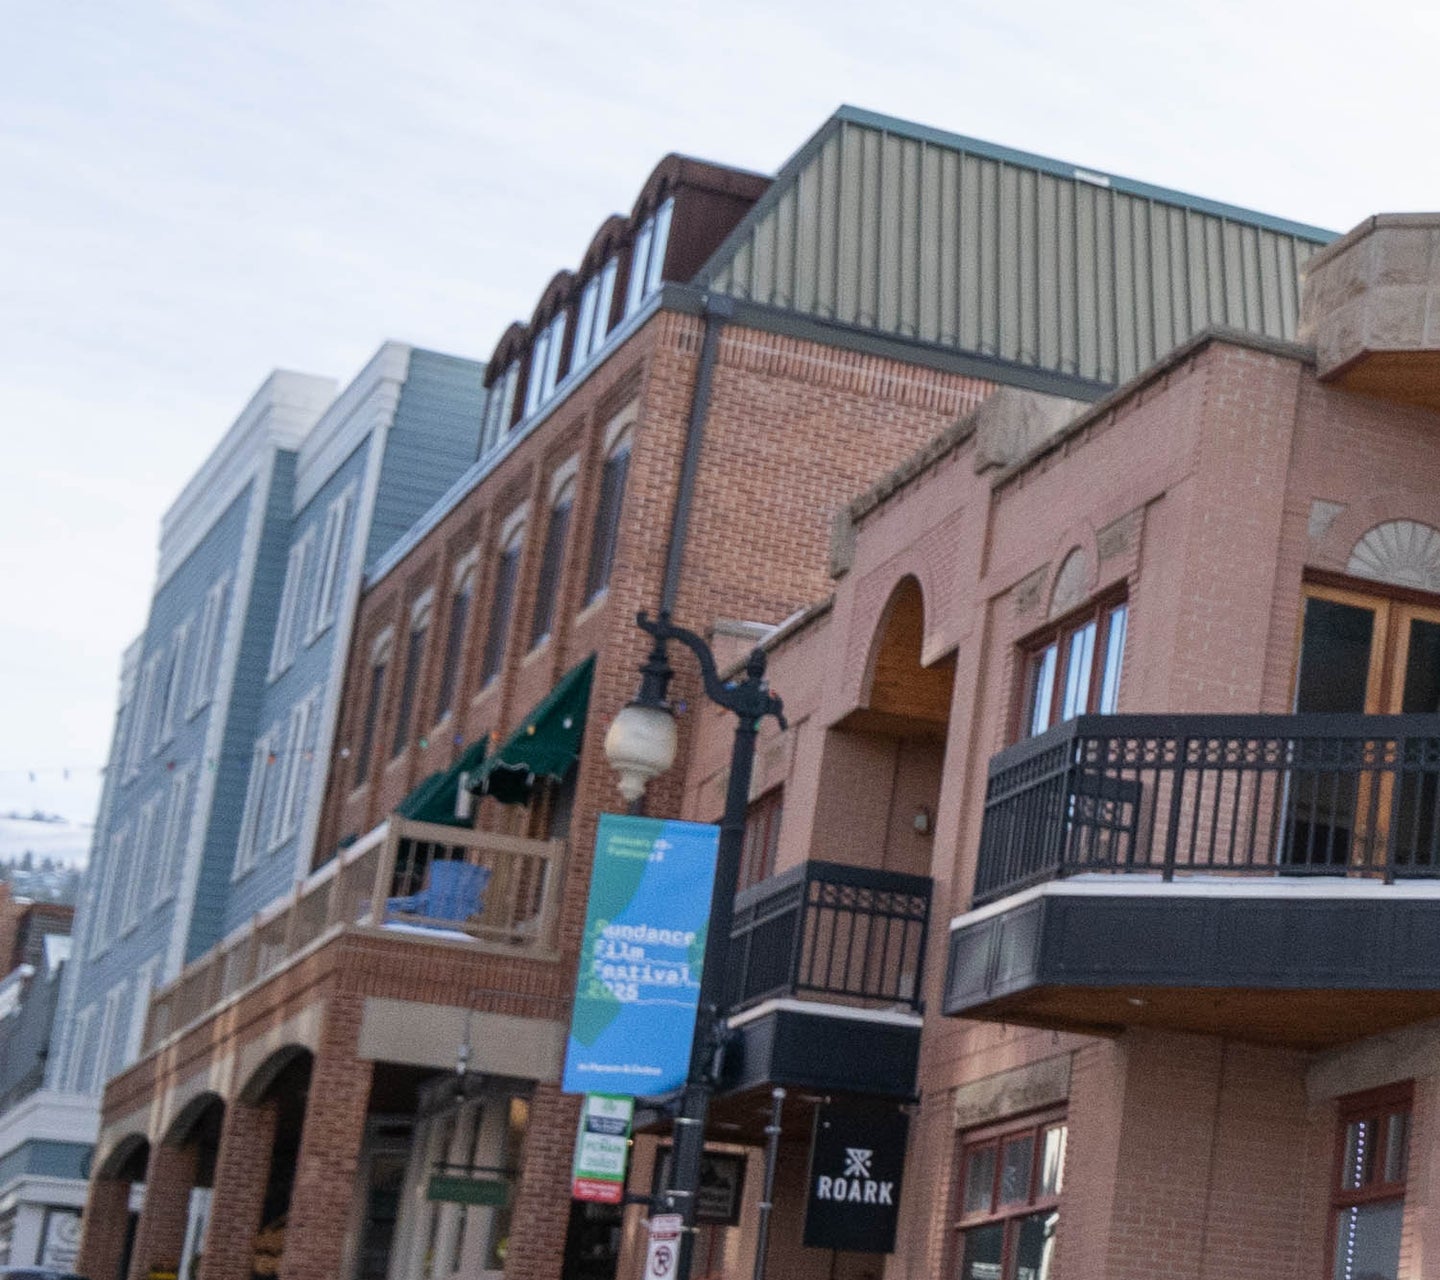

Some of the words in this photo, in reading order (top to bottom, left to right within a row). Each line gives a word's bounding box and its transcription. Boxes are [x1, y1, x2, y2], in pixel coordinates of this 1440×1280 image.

[594, 919, 696, 949] Sundance
[594, 938, 645, 962] Film
[592, 959, 691, 985] Festival
[817, 1175, 894, 1206] ROARK
